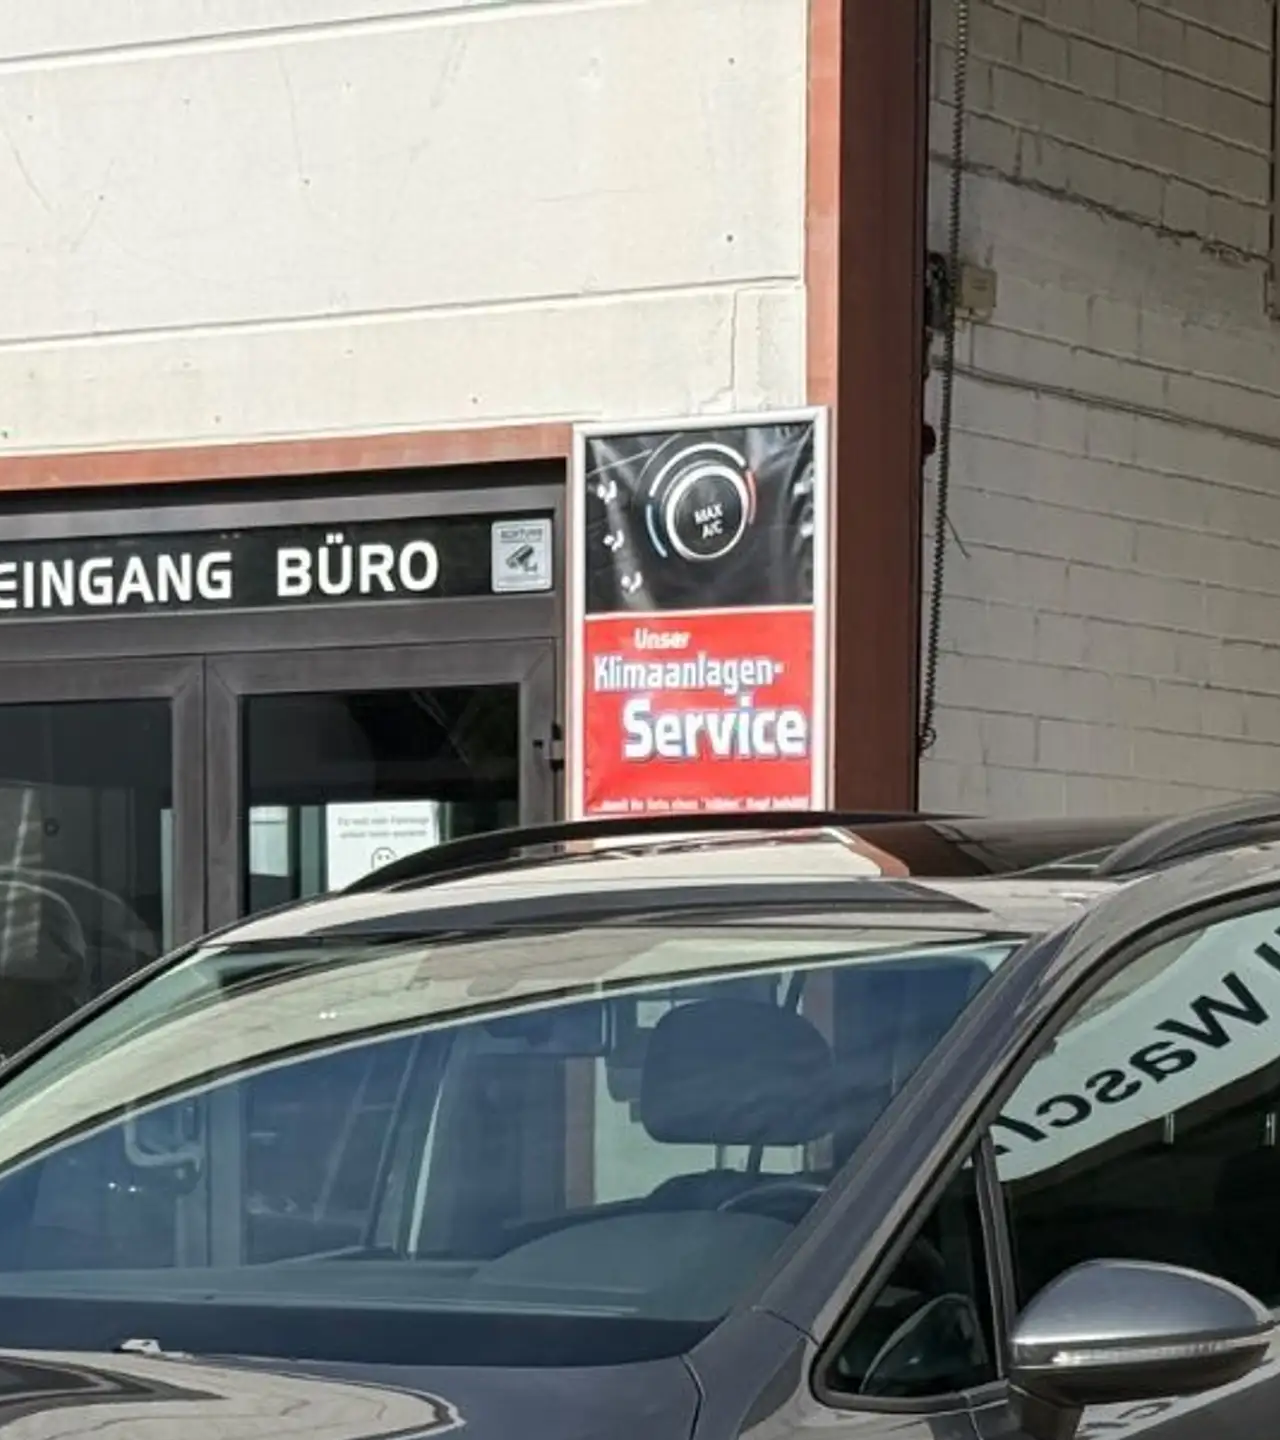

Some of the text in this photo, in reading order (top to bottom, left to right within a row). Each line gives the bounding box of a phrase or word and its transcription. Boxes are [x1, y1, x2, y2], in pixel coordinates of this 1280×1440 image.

[275, 533, 439, 597] BÜRO
[634, 627, 691, 650] Unser
[593, 651, 784, 696] Klimaanlagen-
[623, 696, 808, 759] Service
